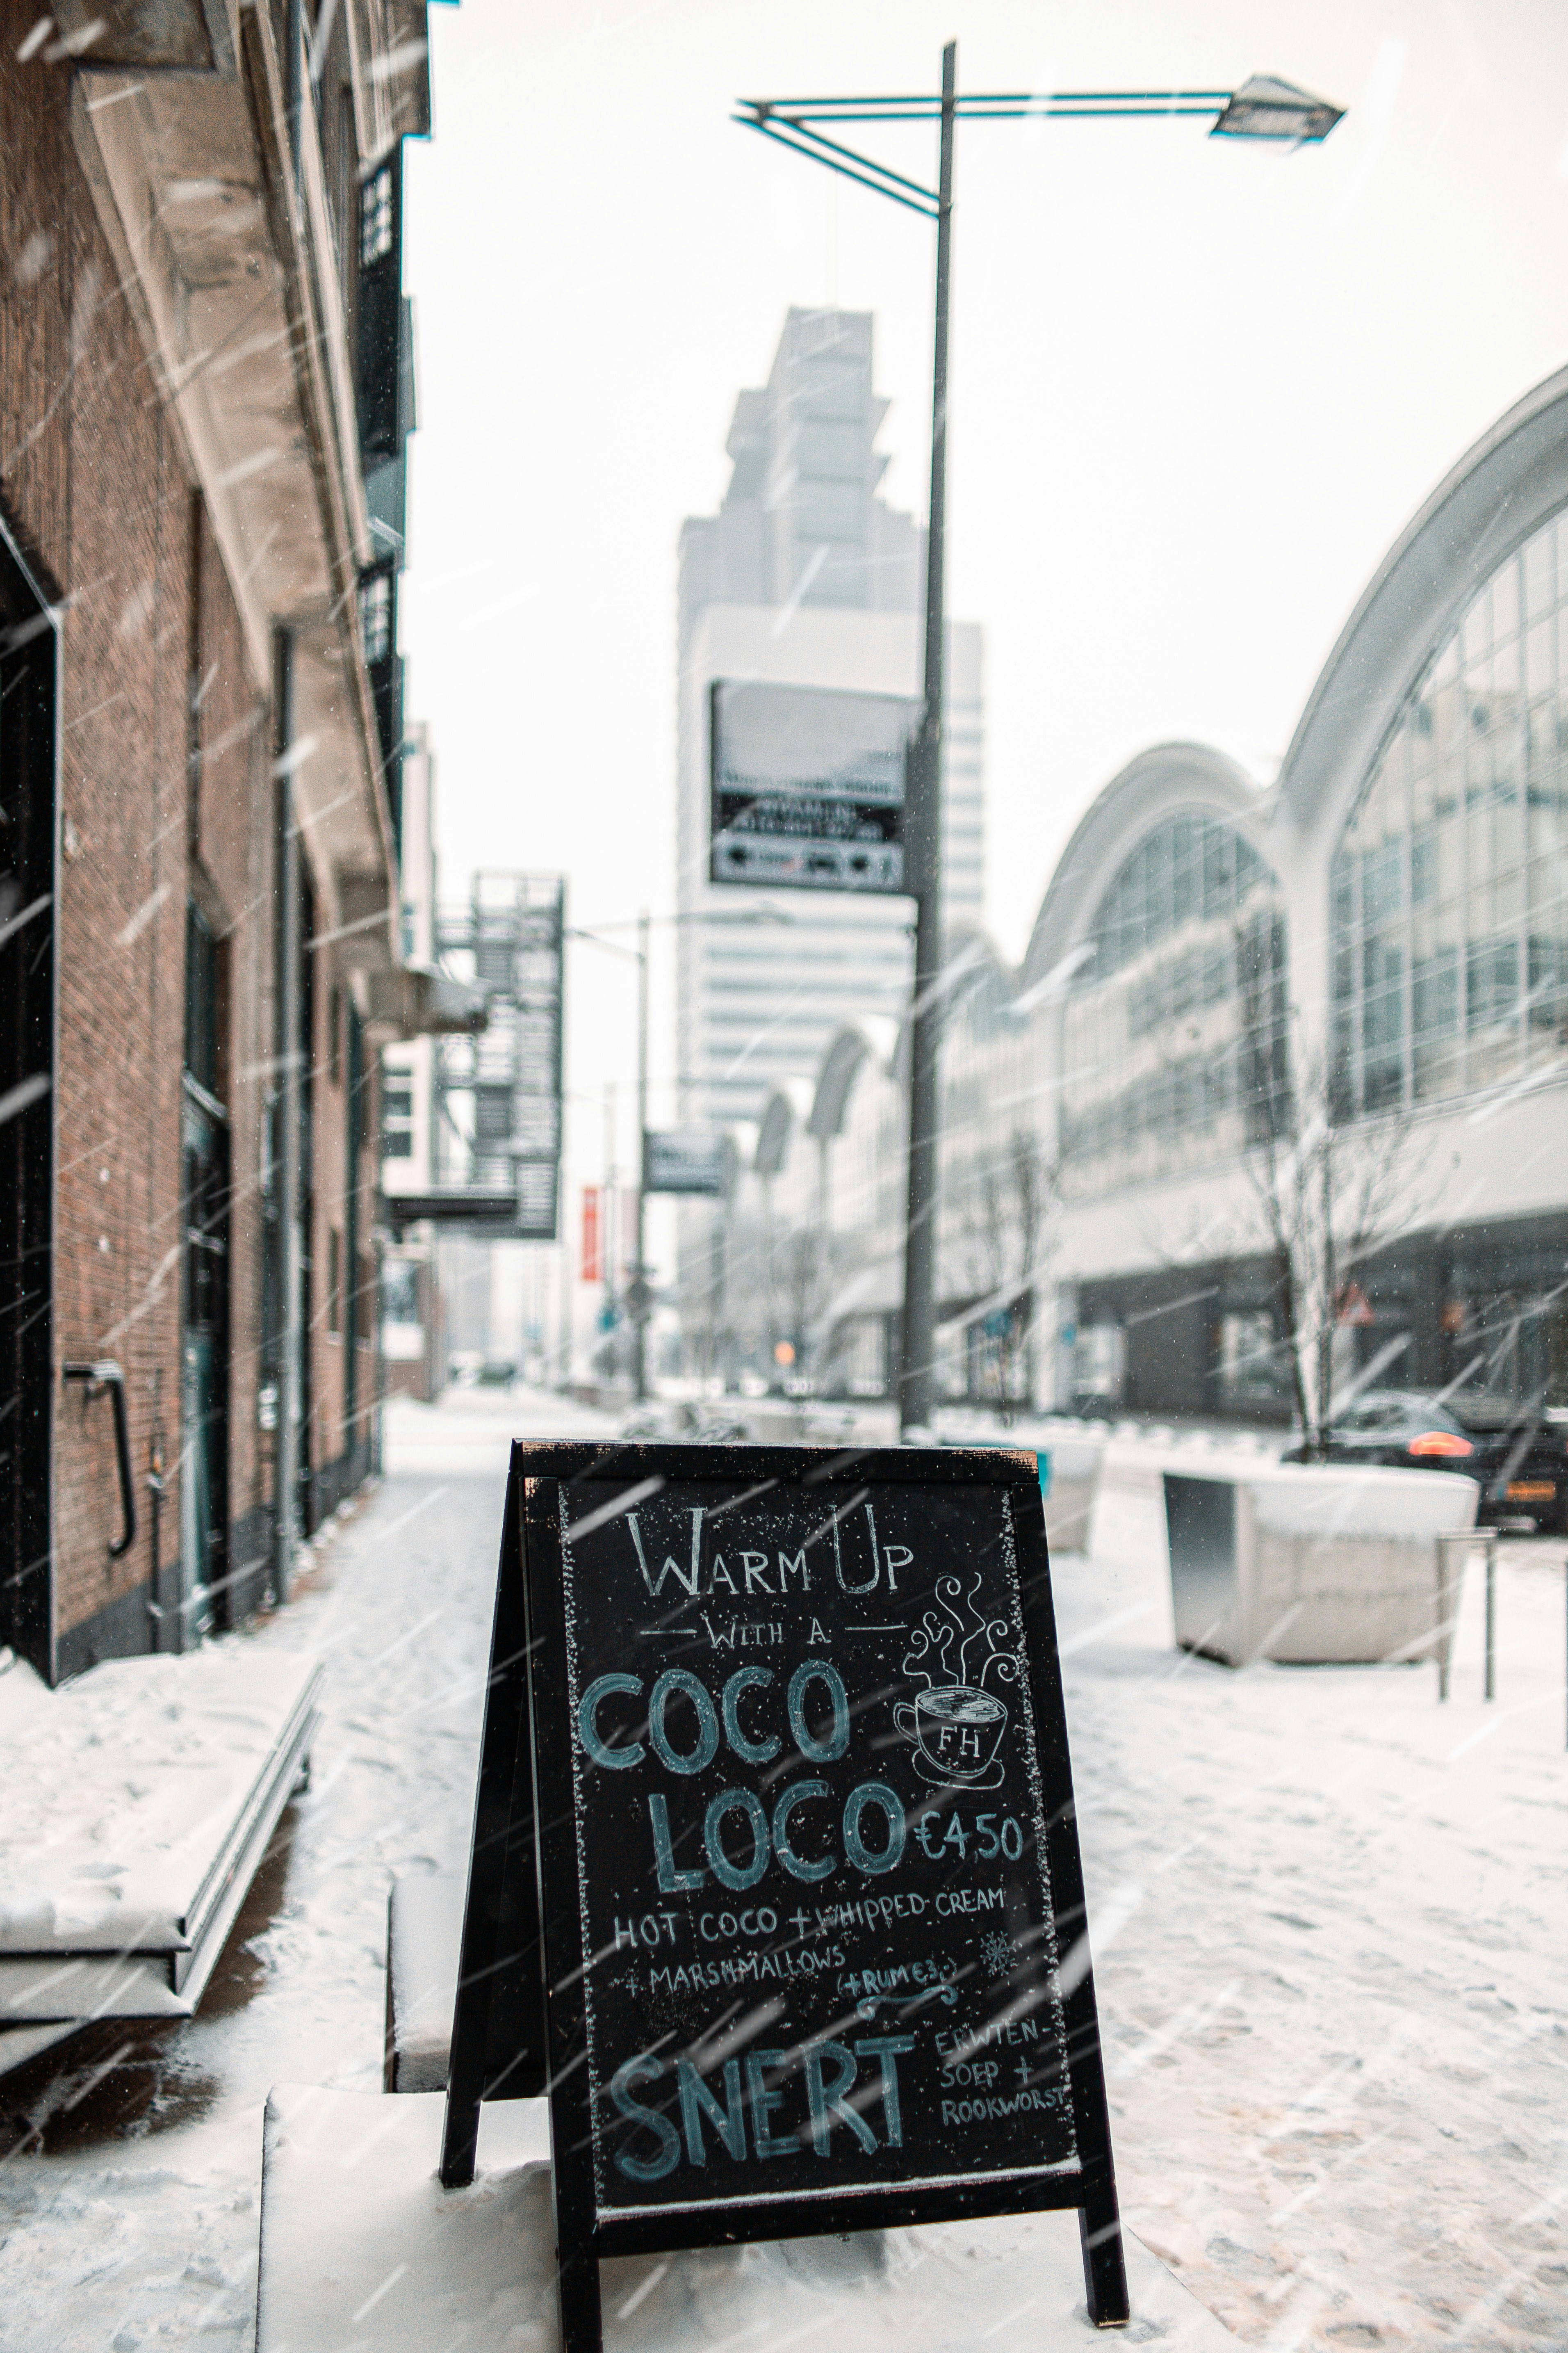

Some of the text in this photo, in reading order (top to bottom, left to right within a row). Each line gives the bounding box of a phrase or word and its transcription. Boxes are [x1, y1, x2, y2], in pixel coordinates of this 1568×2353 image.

[625, 1504, 914, 1597] WARM UP
[700, 1613, 831, 1649] WITH A
[578, 1659, 851, 1775] COCO
[938, 1725, 980, 1757] FH
[648, 1779, 907, 1894] LOCO
[614, 1912, 679, 1950] HOT
[700, 1906, 777, 1942] COCO
[815, 1892, 925, 1932] WHIPPED
[935, 1887, 1005, 1916] CREAM
[650, 1945, 845, 1994] MARSHMALLOWS
[941, 2061, 999, 2088] SOEP
[611, 2034, 916, 2183] SNERT
[941, 2086, 1064, 2126] ROOKWORST
